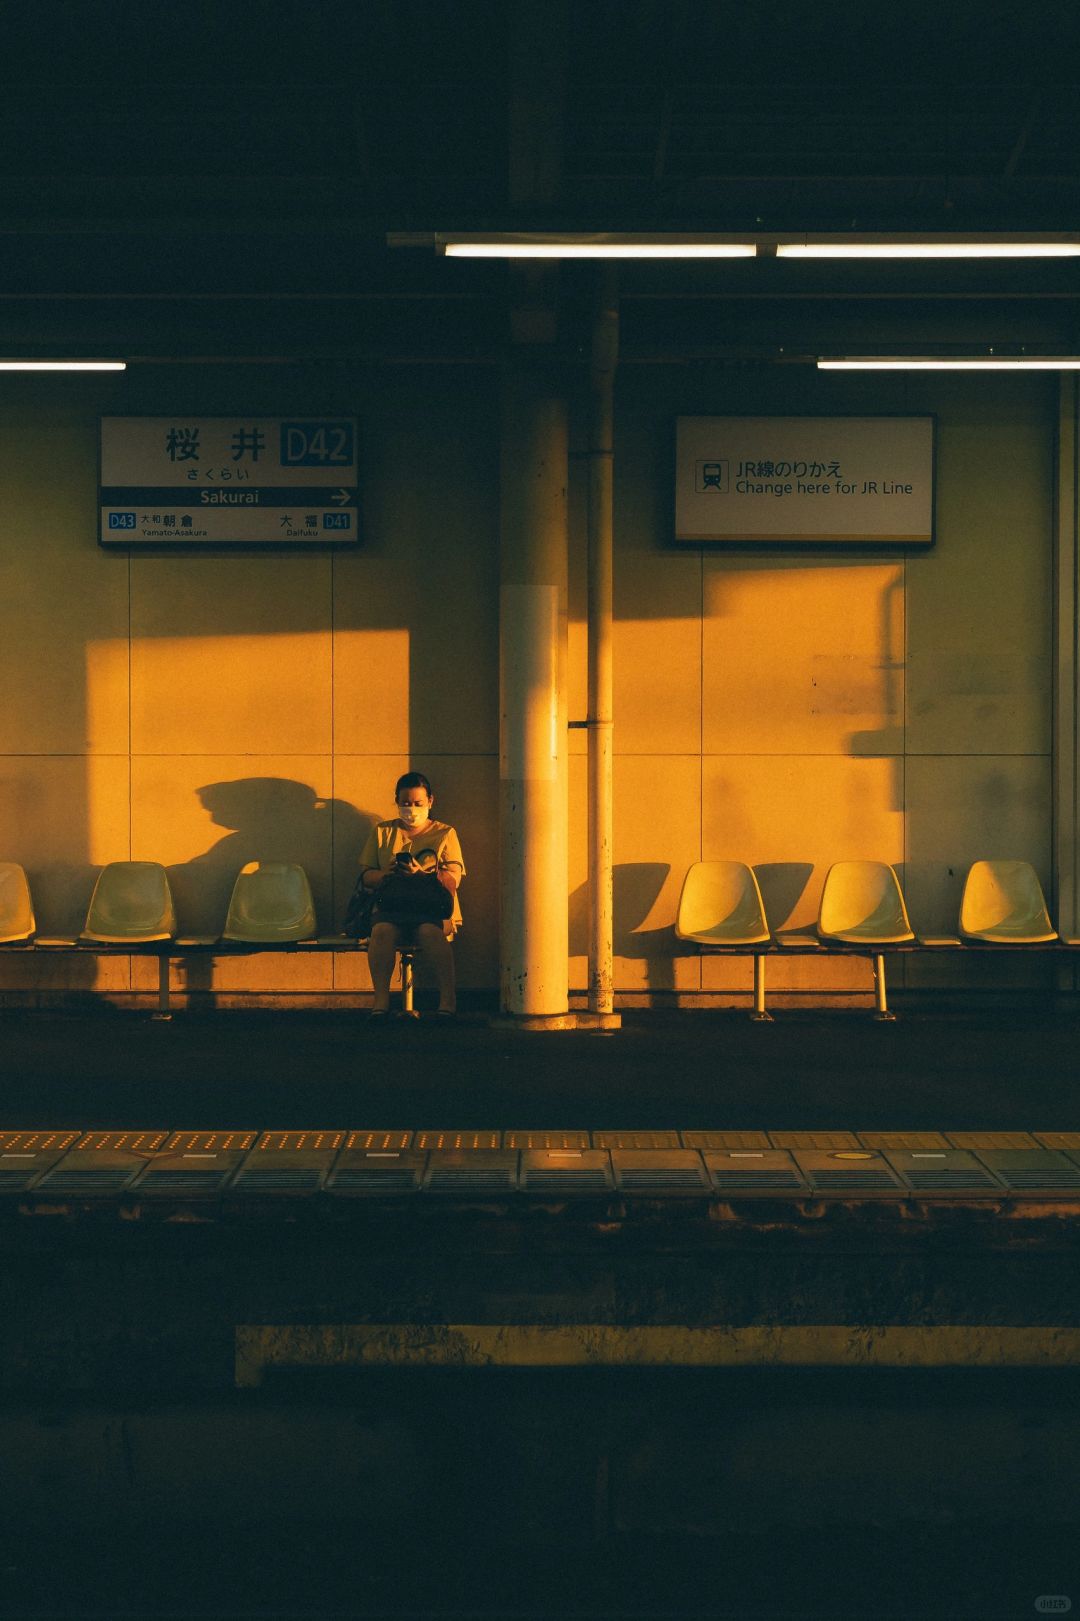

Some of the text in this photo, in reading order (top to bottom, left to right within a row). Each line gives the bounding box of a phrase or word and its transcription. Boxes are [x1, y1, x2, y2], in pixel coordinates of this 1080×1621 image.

[166, 427, 266, 462] 桜井
[287, 428, 348, 461] D42
[186, 468, 249, 480] さくらい
[736, 461, 843, 478] JR線のりかえ
[736, 481, 913, 497] Change here for JR Line
[200, 490, 259, 504] Sakurai
[110, 514, 134, 528] D43
[280, 514, 318, 528] 大福
[326, 514, 349, 528] D41
[142, 529, 208, 537] Yamato-Asakura
[286, 529, 318, 537] Daifuku
